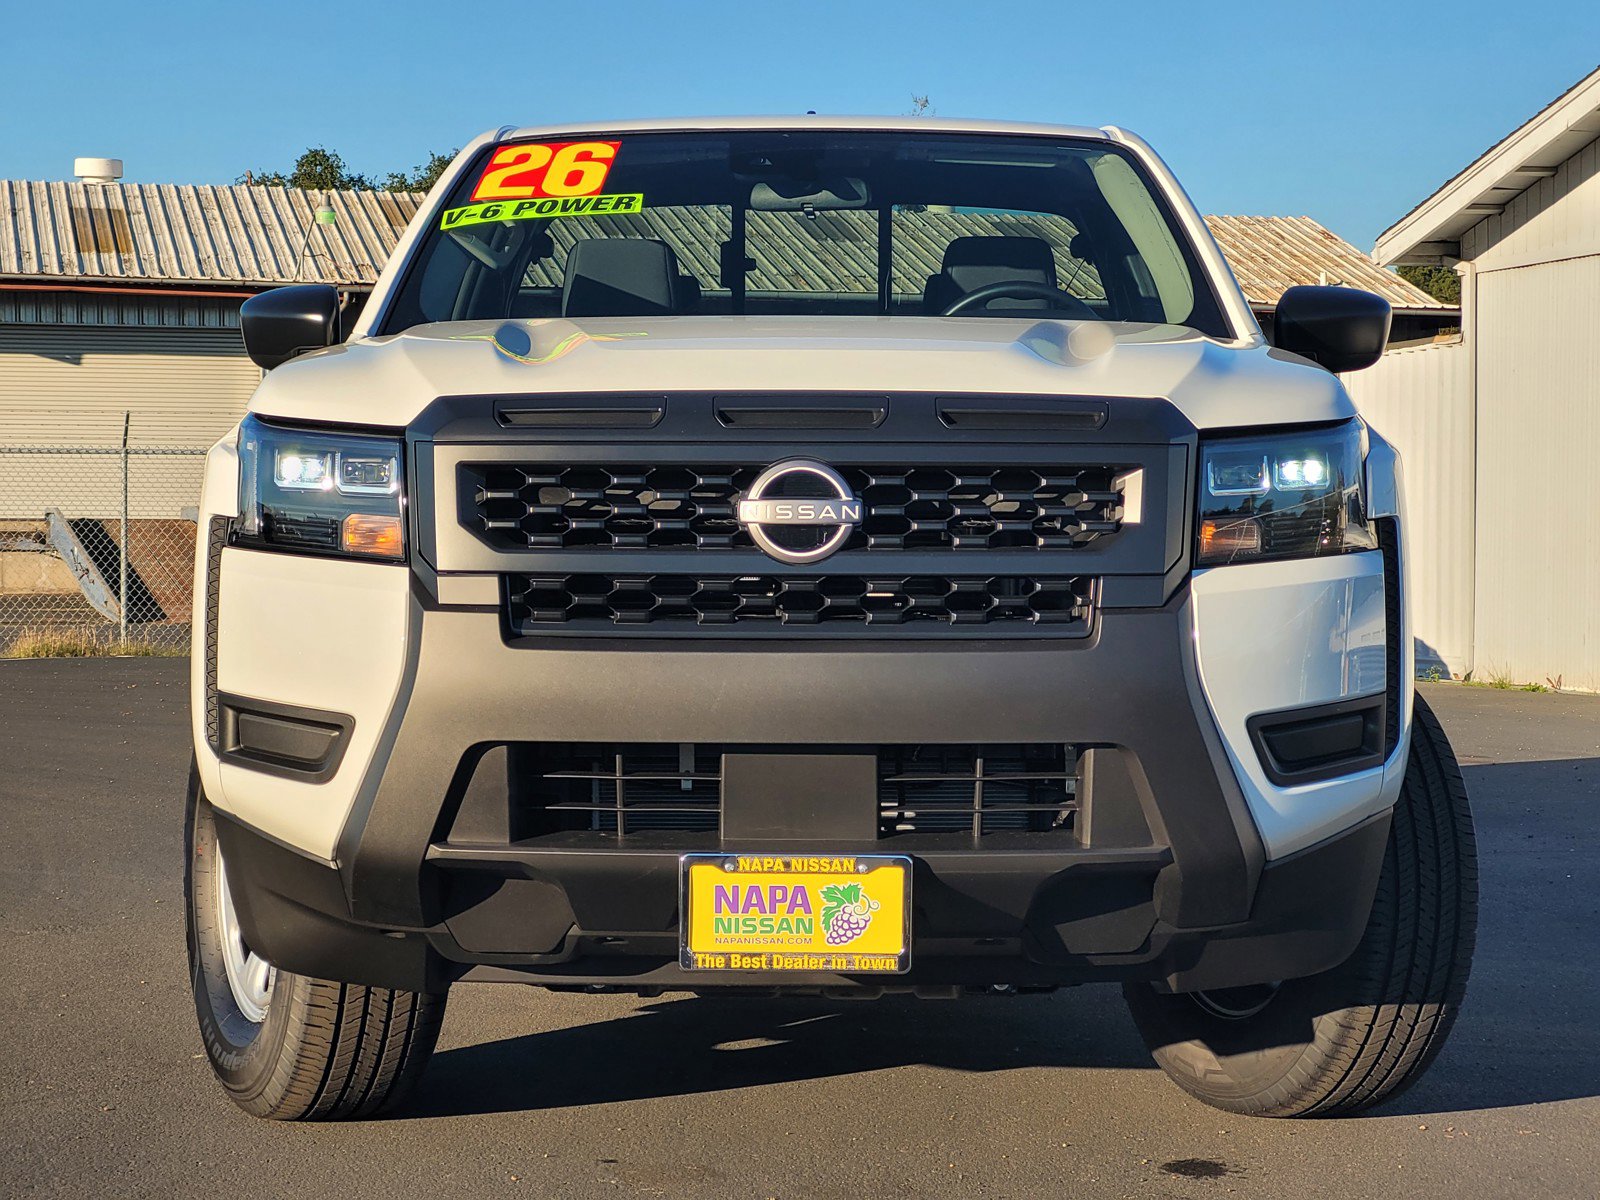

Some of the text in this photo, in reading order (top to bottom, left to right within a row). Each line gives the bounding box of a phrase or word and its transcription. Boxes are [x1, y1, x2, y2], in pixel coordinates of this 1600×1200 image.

[473, 142, 615, 198] 26
[444, 196, 640, 225] V-6 POWER
[743, 505, 859, 520] NISSAN
[739, 857, 855, 872] NAPA NISSAN
[714, 885, 813, 915] NAPA
[714, 917, 813, 935] NISSAN
[715, 937, 812, 945] NAPANISSAN.COM
[696, 953, 896, 970] The Best Dealer in Town
